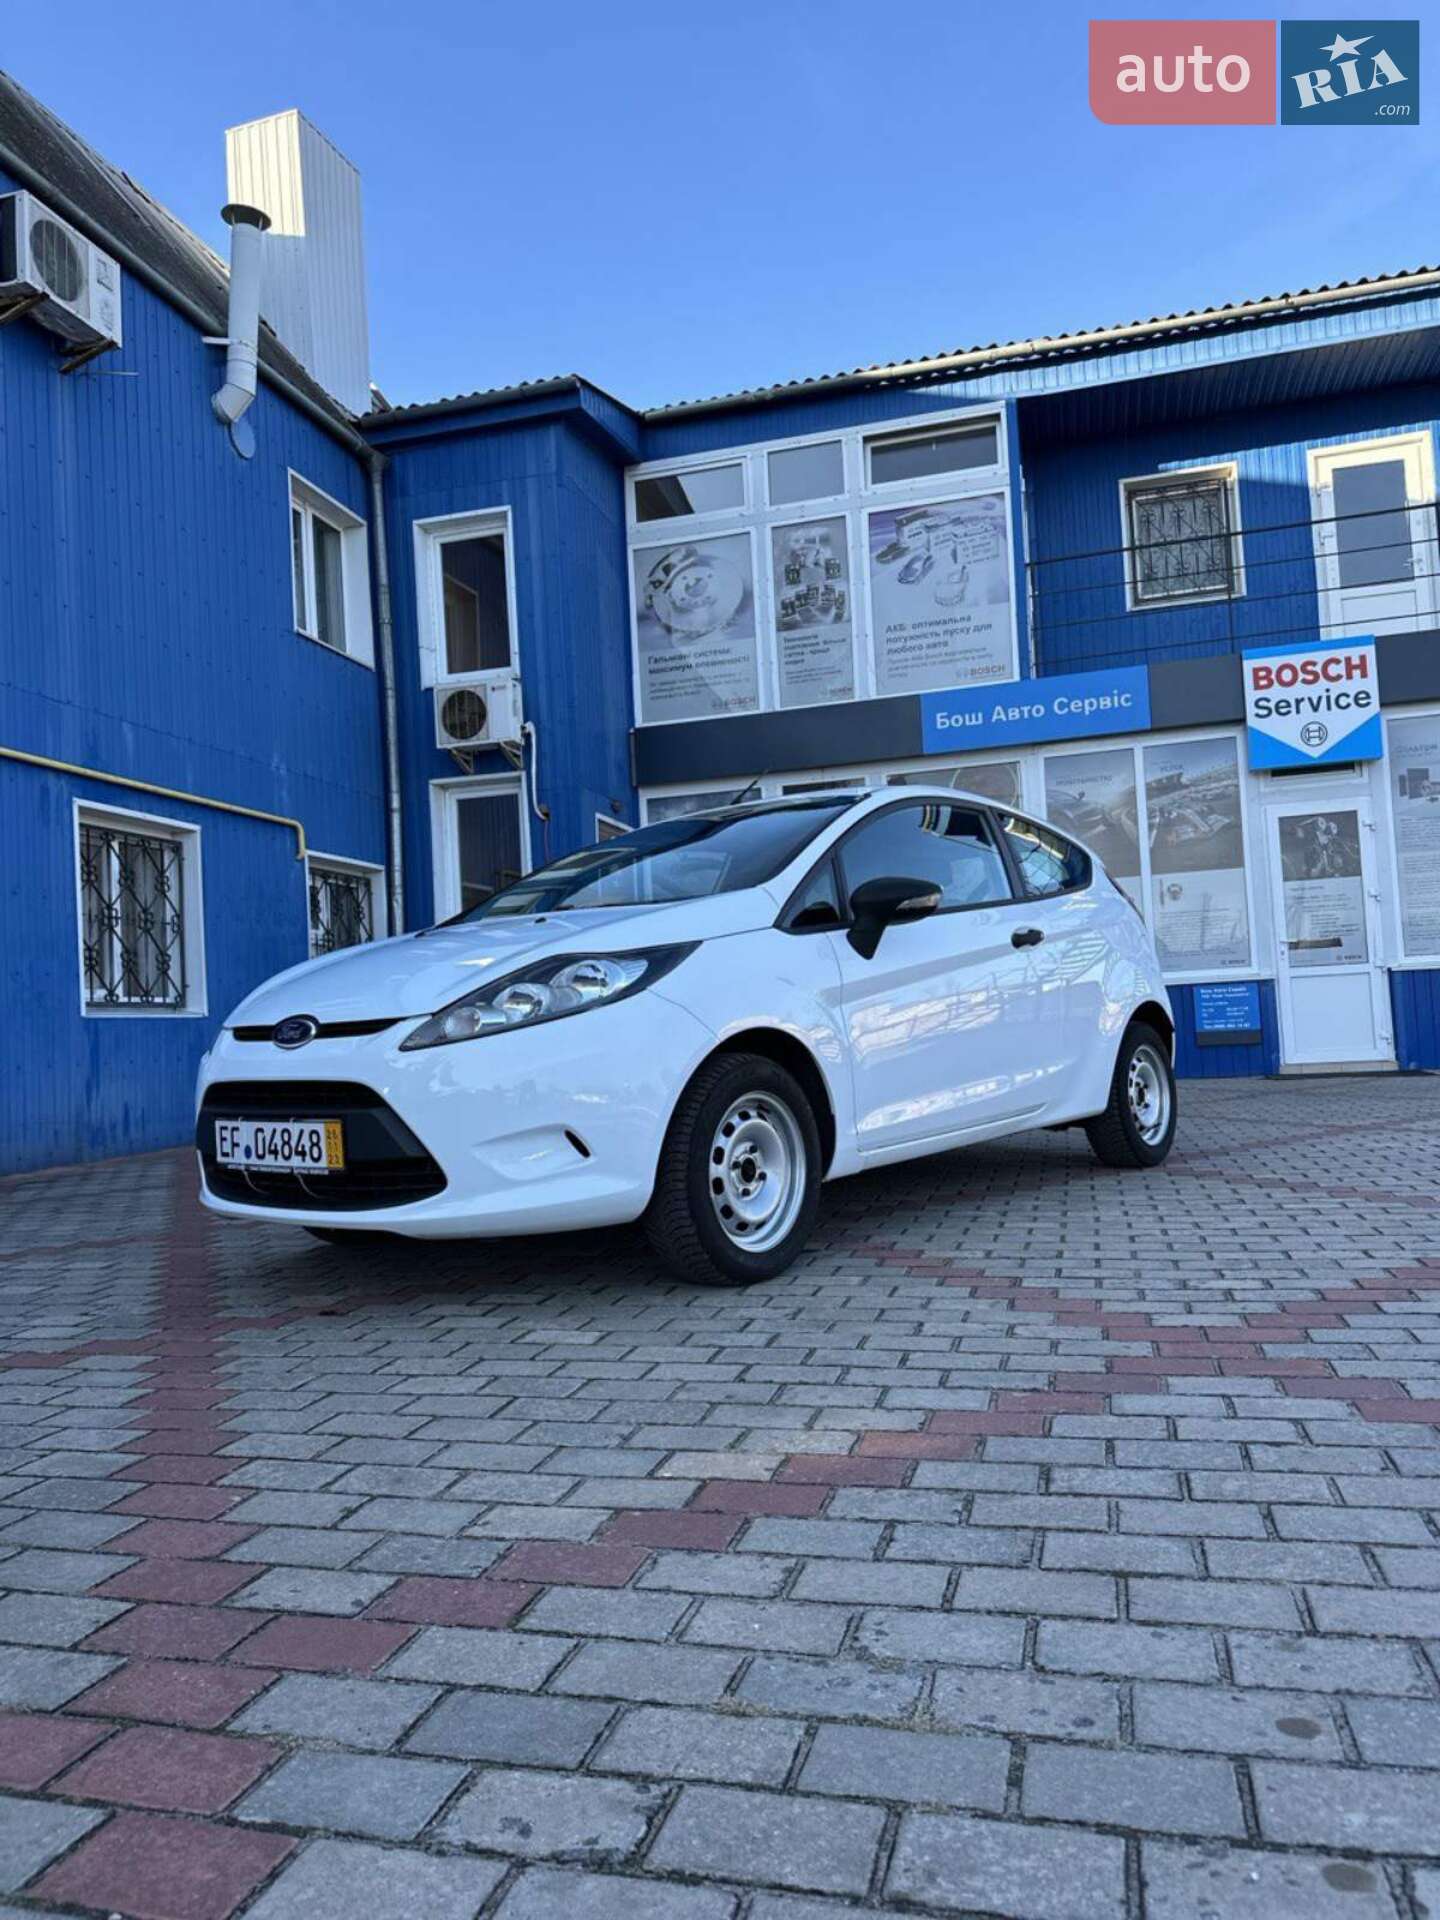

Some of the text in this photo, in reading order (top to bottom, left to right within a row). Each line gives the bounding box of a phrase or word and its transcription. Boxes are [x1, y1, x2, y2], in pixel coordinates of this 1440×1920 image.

[1251, 654, 1369, 691] BOSCH
[935, 689, 1133, 730] Бош Авто Сервіс
[1253, 687, 1373, 719] Service
[219, 1125, 241, 1158] EF
[254, 1127, 323, 1163] 04848
